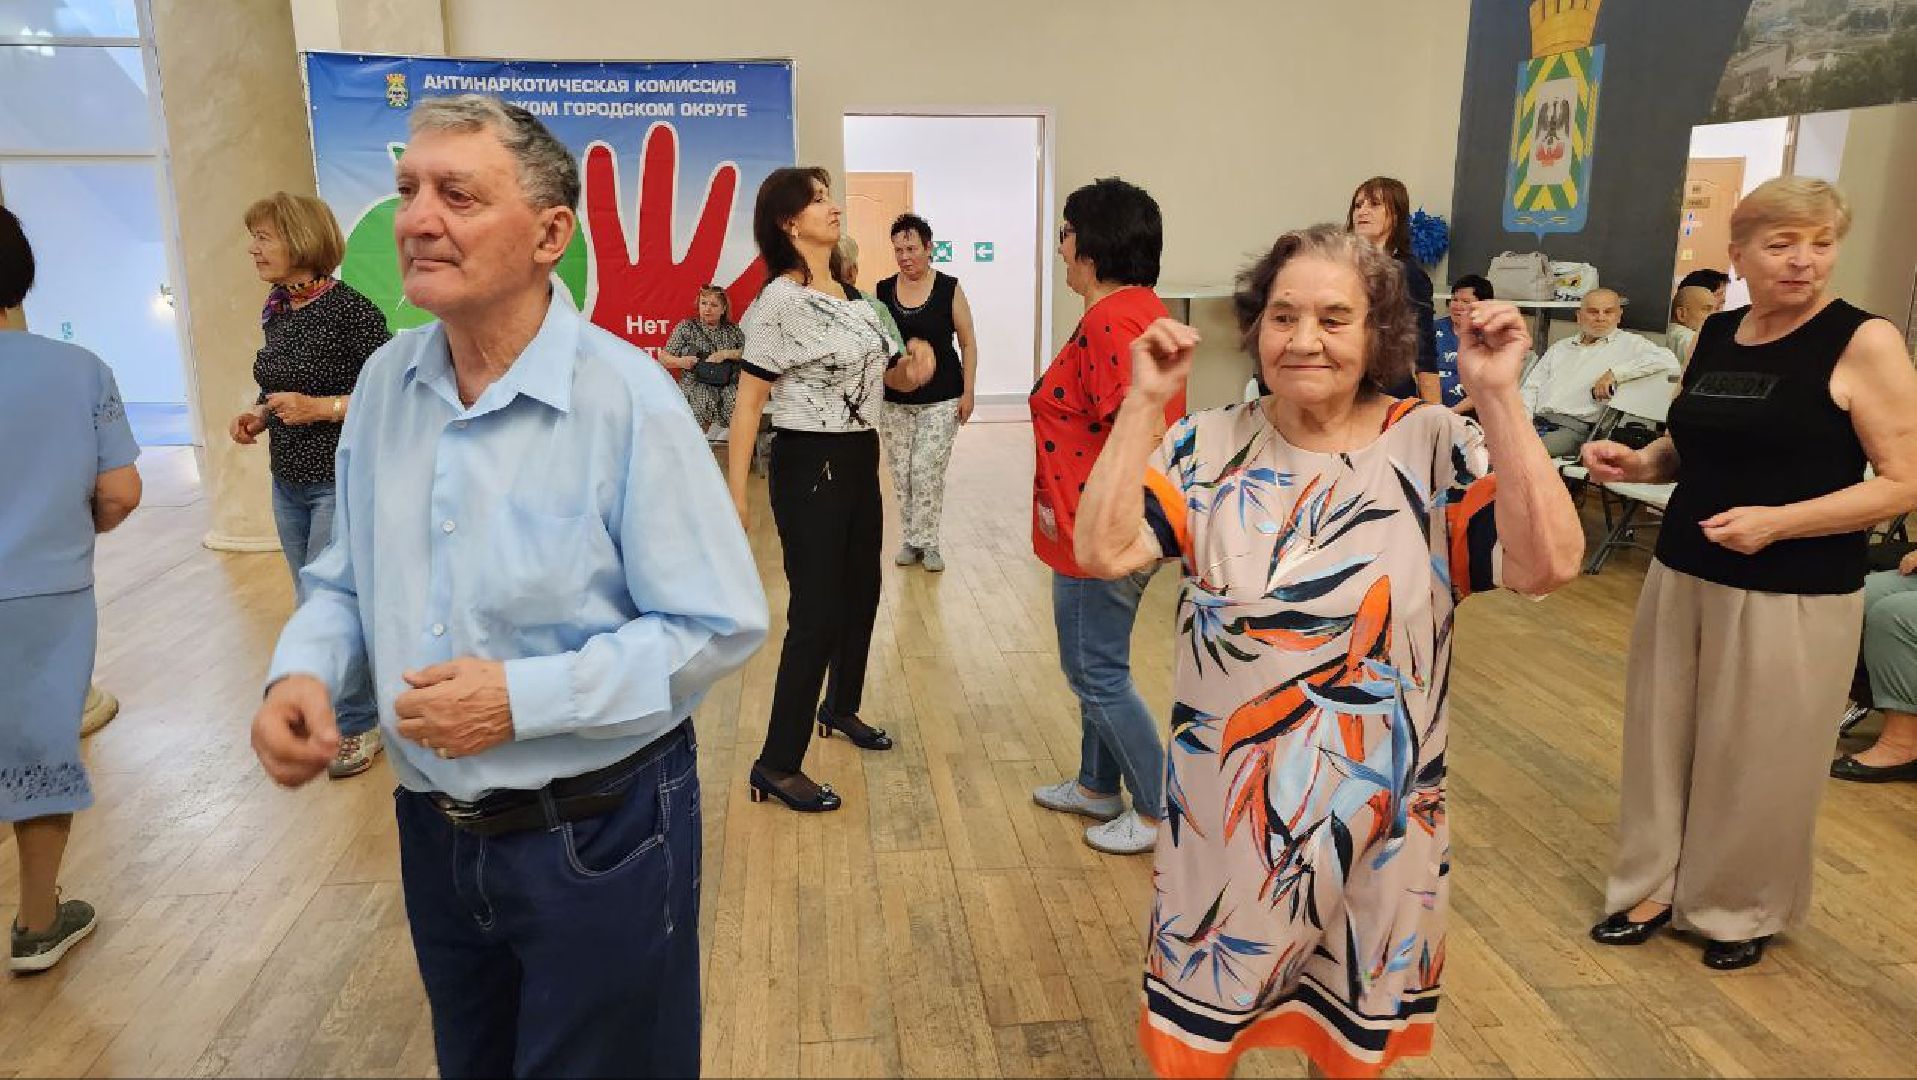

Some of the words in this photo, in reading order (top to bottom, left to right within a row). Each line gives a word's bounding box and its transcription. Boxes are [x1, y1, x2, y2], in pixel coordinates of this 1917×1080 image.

[424, 74, 630, 93] АНТИНАРКОТИЧЕСКАЯ
[635, 79, 737, 95] КОМИССИЯ
[563, 101, 675, 118] ГОРОДСКОМ
[680, 103, 749, 117] ОКРУГЕ
[626, 315, 670, 335] Нет
